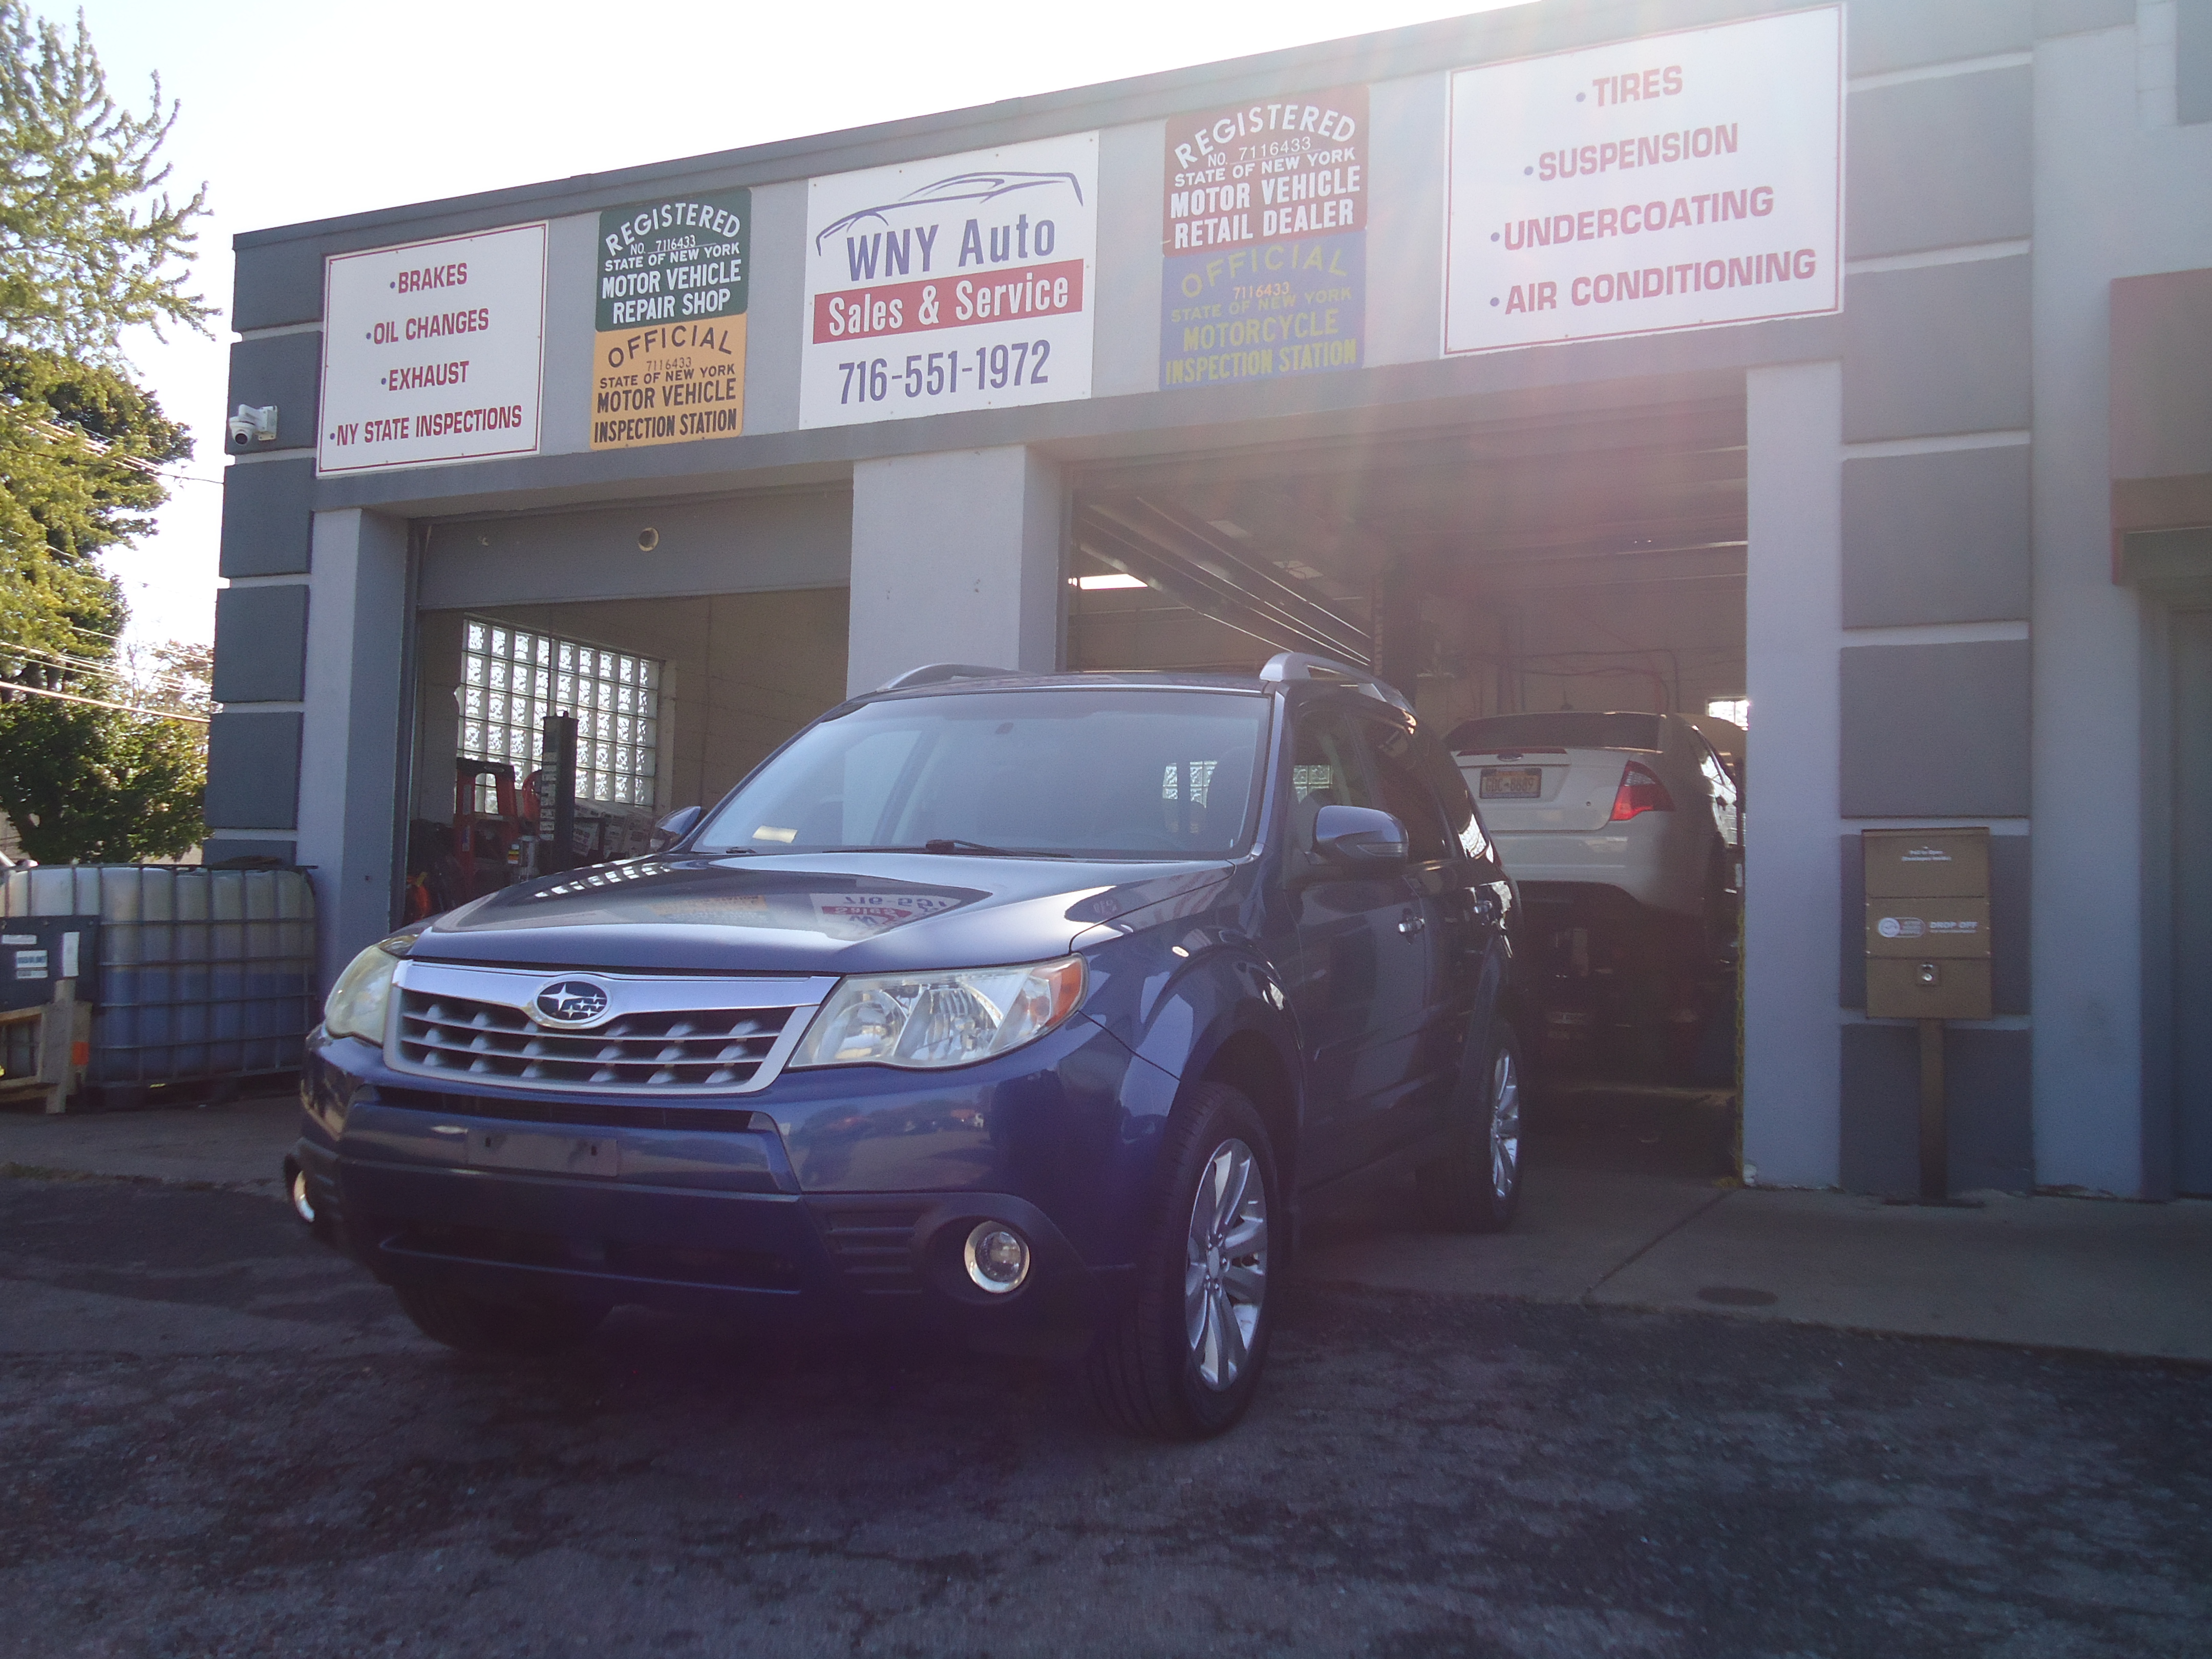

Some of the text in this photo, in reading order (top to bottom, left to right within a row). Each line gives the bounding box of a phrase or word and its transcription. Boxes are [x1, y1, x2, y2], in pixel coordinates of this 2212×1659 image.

[1592, 65, 1683, 108] TIRES
[1174, 103, 1355, 169] REGISTERED
[1207, 136, 1311, 167] NO. 7116433
[1539, 123, 1738, 182] SUSPENSION
[1175, 147, 1356, 188] STATE OF NEW YORK
[1170, 165, 1360, 219] MOTOR VEHICLE
[605, 203, 740, 256] REGISTERED
[1175, 198, 1354, 249] RETAIL DEALER
[1504, 186, 1774, 251] UNDERCOATING
[605, 242, 740, 272] STATE OF NEW YORK
[655, 235, 696, 252] 7116433
[846, 214, 1055, 282] WNY Auto
[398, 262, 467, 294] BRAKES
[602, 259, 741, 299] MOTOR VEHICLE
[1181, 244, 1348, 298] OFFICIAL
[1232, 282, 1290, 300] 7116433
[1505, 248, 1816, 315] AIR CONDITIONING
[613, 288, 731, 324] REPAIR SHOP
[828, 272, 1069, 336] Sales & Service
[1171, 287, 1352, 323] STATE OF NEW YORK
[373, 308, 489, 345] OIL CHANGES
[608, 325, 732, 368] OFFICIAL
[1183, 308, 1339, 352] MOTORCYCLE
[388, 360, 470, 391] EXHAUST
[600, 364, 735, 389] STATE OF NEW YORK
[646, 357, 692, 372] 7116433
[838, 339, 1051, 405] 716-551-1972
[1165, 338, 1357, 385] INSPECTION STATION
[597, 378, 736, 414] MOTOR VEHICLE
[337, 405, 522, 446] NY STATE INSPECTIONS
[594, 408, 737, 443] INSPECTION STATION
